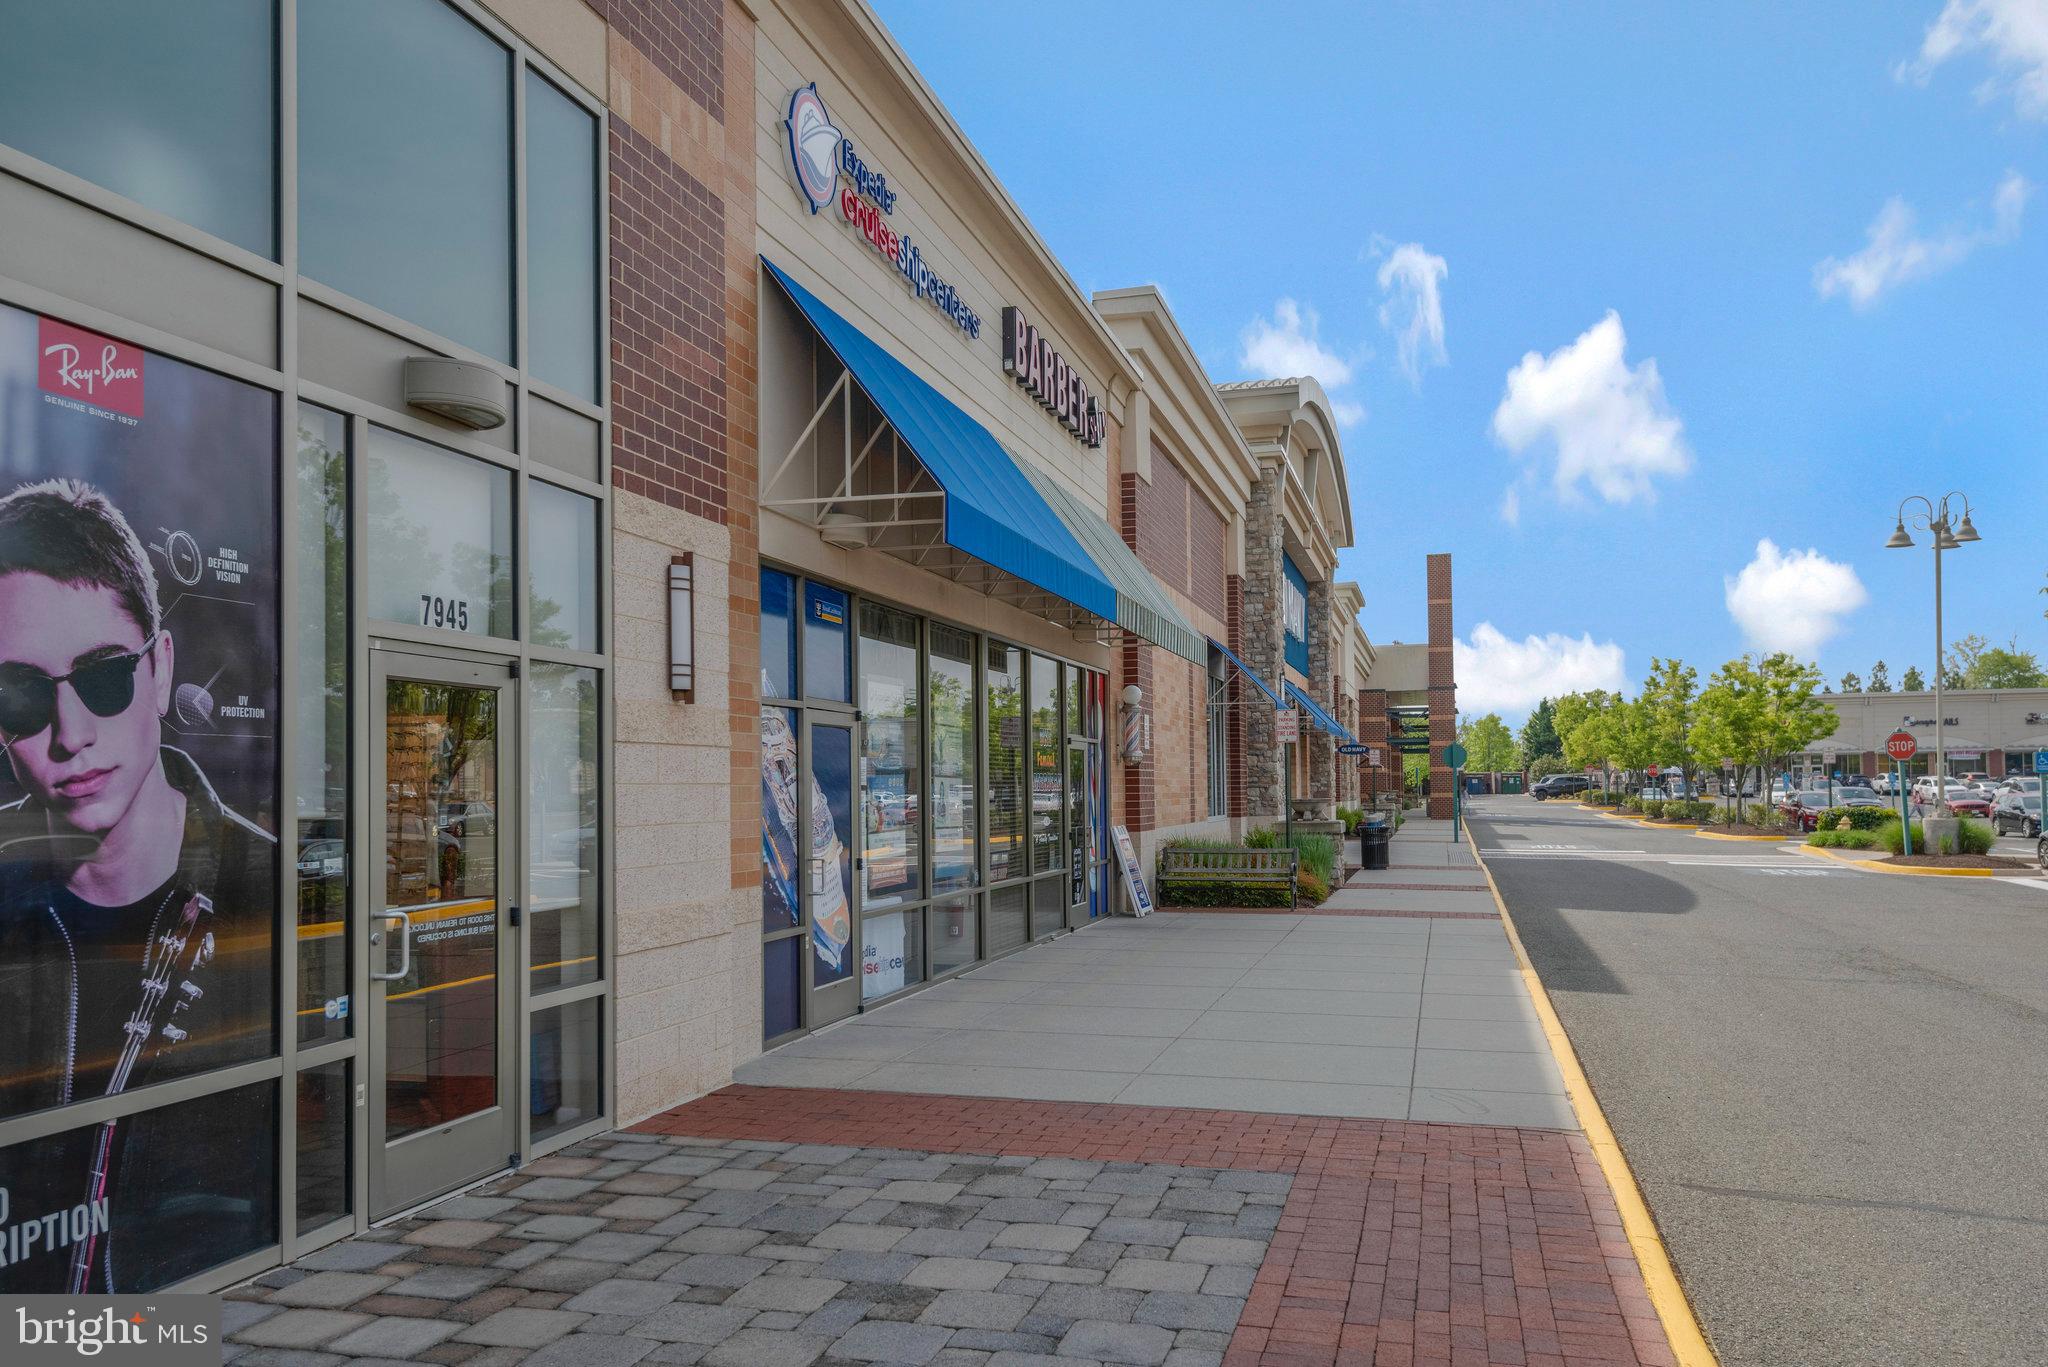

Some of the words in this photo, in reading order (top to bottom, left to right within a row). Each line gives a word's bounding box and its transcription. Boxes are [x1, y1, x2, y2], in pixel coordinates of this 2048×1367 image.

[843, 139, 894, 215] Expedia
[1005, 306, 1089, 443] BARBER
[45, 395, 86, 414] GENUINE
[89, 406, 116, 421] SINCE
[118, 415, 138, 427] 1937
[219, 548, 238, 561] HIGH
[208, 557, 249, 574] DEFINITION
[216, 570, 241, 584] VISION
[421, 594, 467, 631] 7945
[238, 695, 249, 706] UV
[221, 706, 265, 718] PROTECTION
[1888, 740, 1914, 752] STOP
